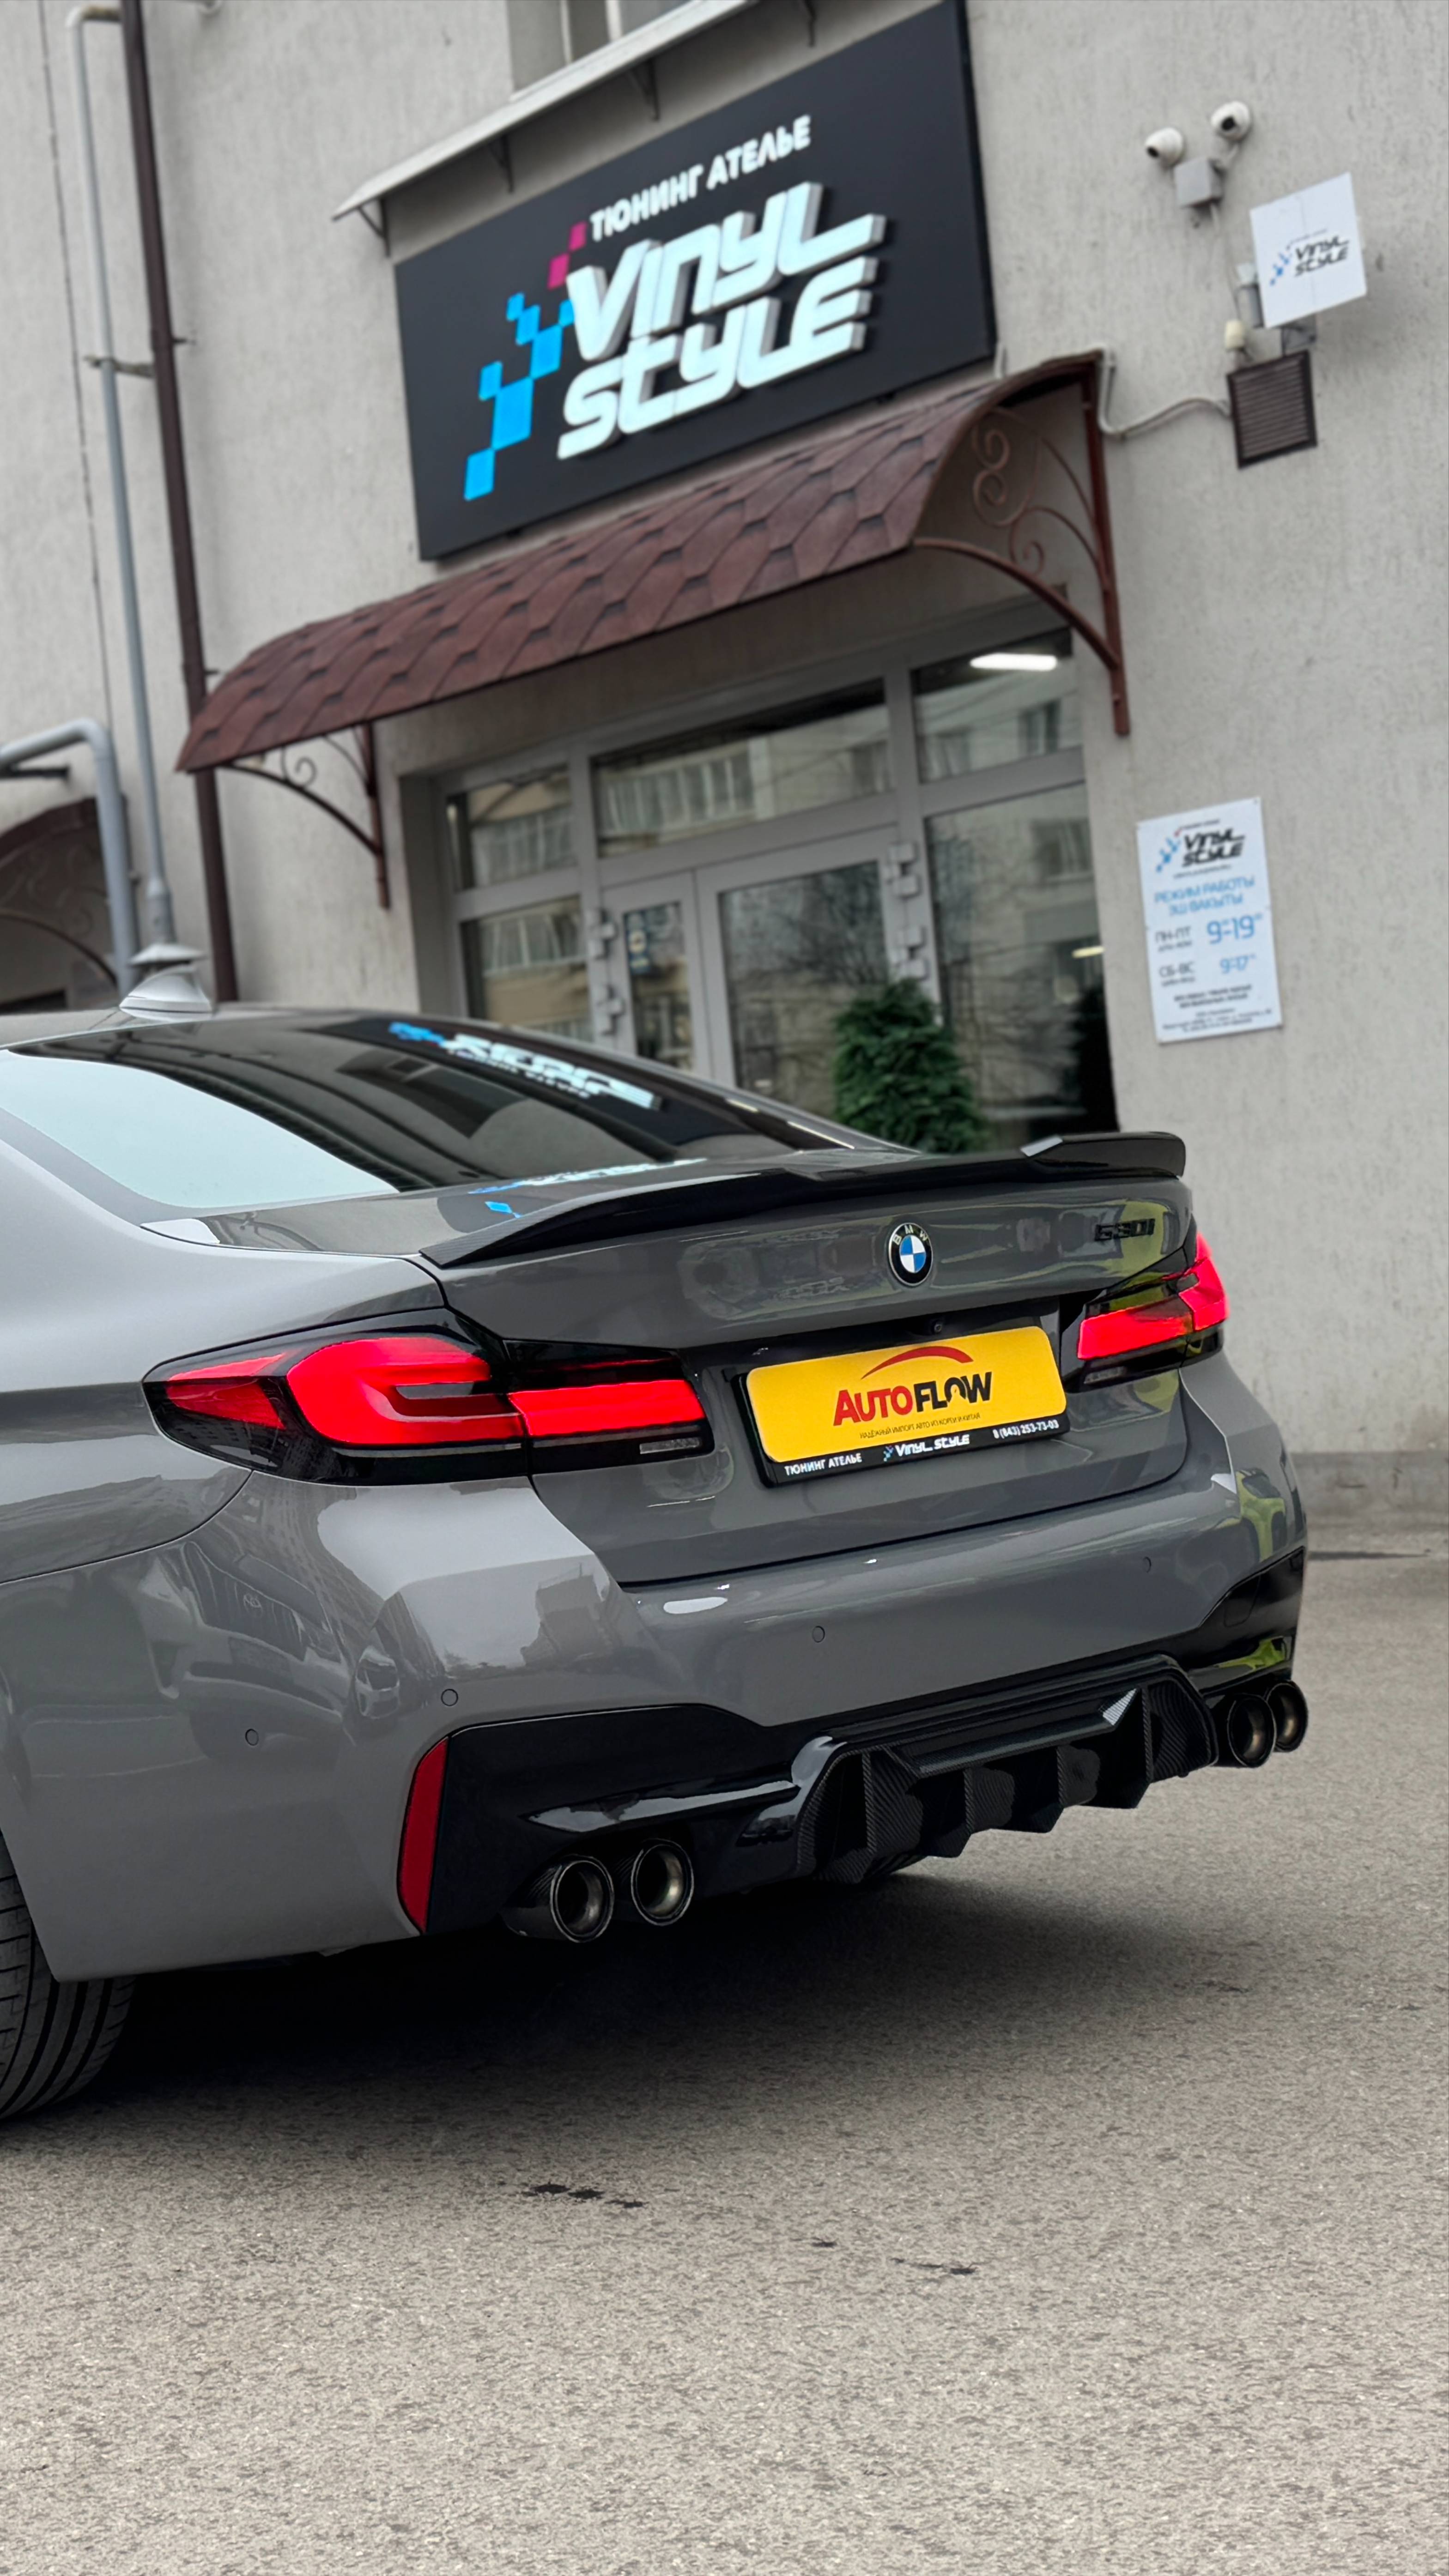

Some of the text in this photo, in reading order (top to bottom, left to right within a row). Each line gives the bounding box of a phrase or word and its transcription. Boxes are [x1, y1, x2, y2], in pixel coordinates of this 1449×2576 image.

[590, 114, 812, 242] ТЮНИНГ АТЕЛЬЕ
[1154, 876, 1255, 903] РЕЖИМ РАБОТЫ
[1155, 925, 1191, 943] ПН-ПТ
[892, 1224, 928, 1246] BMW
[892, 1423, 915, 1435] ИМПОРТ
[916, 1421, 931, 1430] АВТО
[993, 1428, 1000, 1439] 8
[1000, 1425, 1021, 1439] (843)
[784, 1452, 862, 1476] ТЮНИНГ АТЕЛЬЕ
